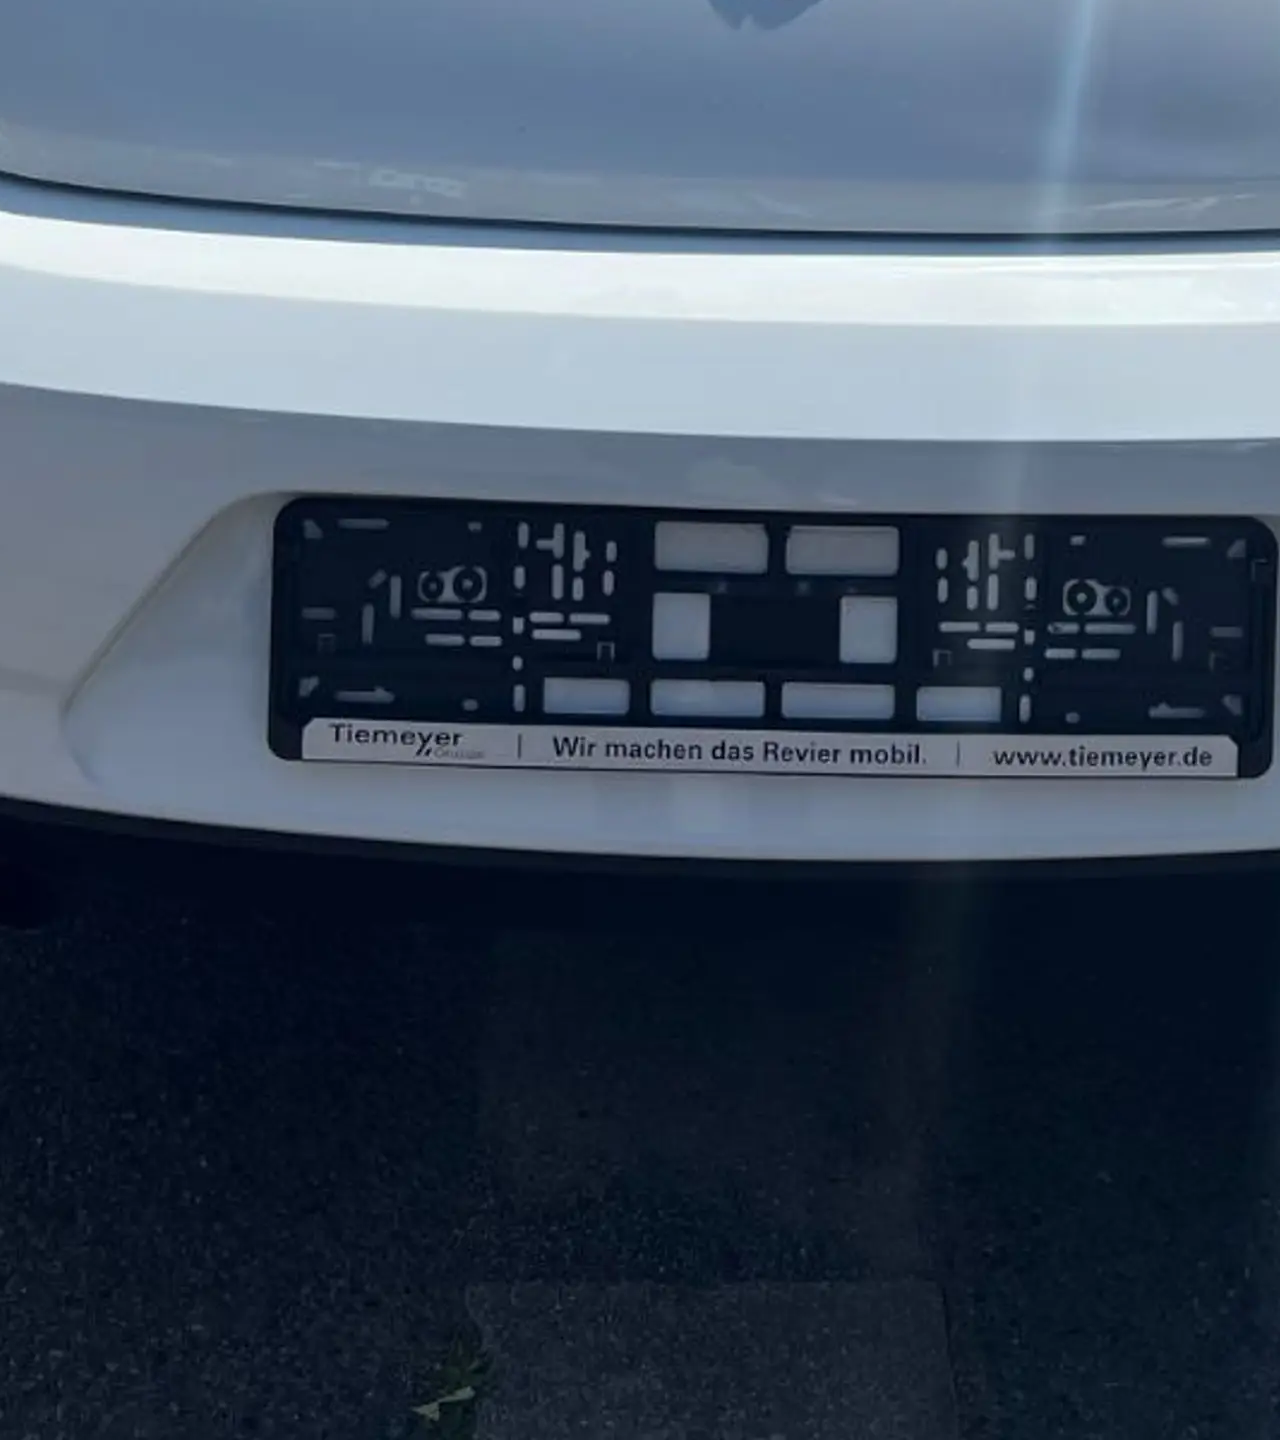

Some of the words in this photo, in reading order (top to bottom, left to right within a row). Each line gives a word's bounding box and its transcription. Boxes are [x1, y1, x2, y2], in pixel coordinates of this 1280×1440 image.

[328, 722, 463, 757] Tiemeyer
[552, 735, 596, 758] Wir
[605, 738, 701, 761] machen
[711, 739, 755, 762] das
[763, 740, 842, 765] Revier
[993, 744, 1214, 772] www.tiemeyer.de
